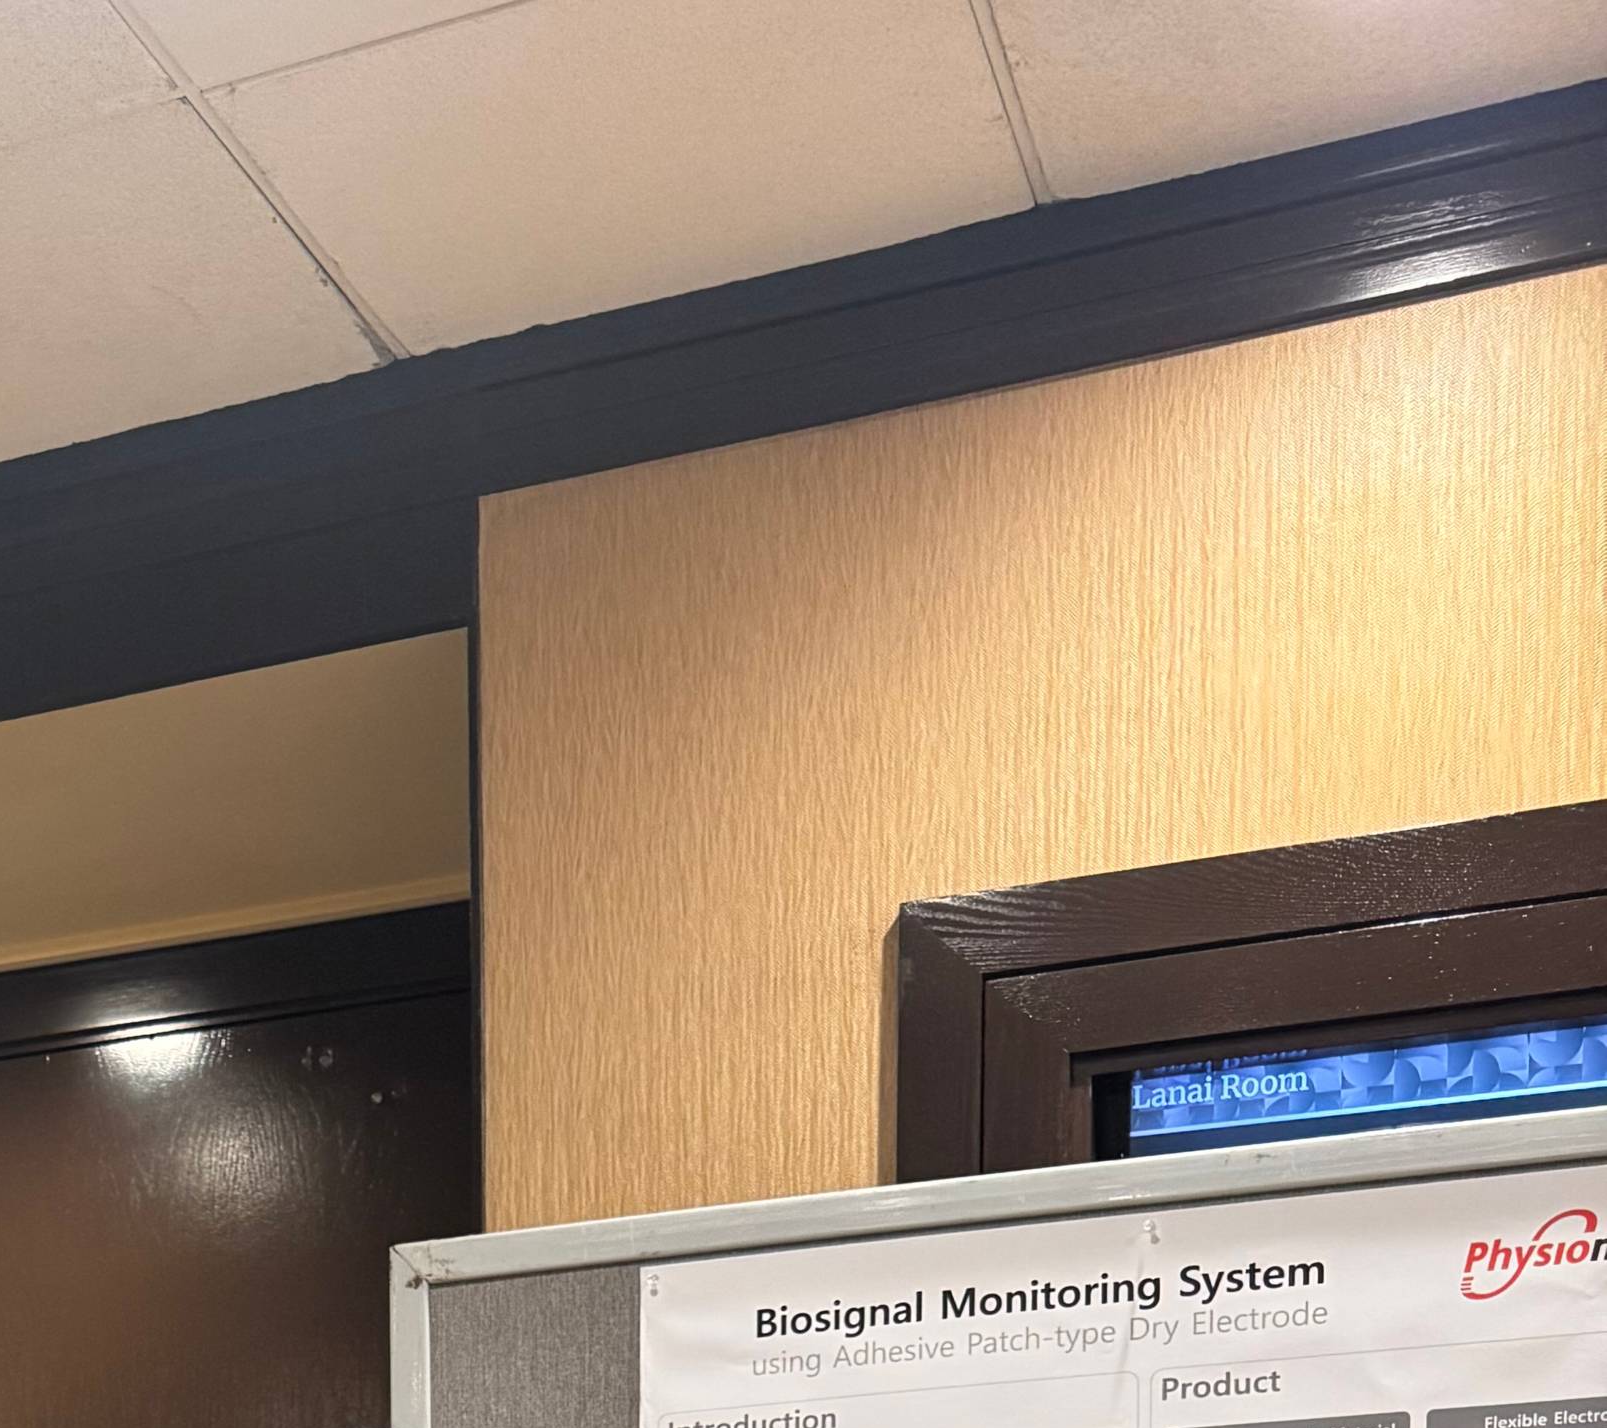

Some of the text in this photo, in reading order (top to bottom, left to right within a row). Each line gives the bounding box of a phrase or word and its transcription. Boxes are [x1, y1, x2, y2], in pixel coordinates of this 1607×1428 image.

[1133, 1068, 1309, 1109] Lanai Room
[756, 1260, 1325, 1338] Biosignal Monitoring System
[752, 1301, 1328, 1378] using Adhesive Patch-type Dry Electrode
[1162, 1370, 1281, 1401] Product
